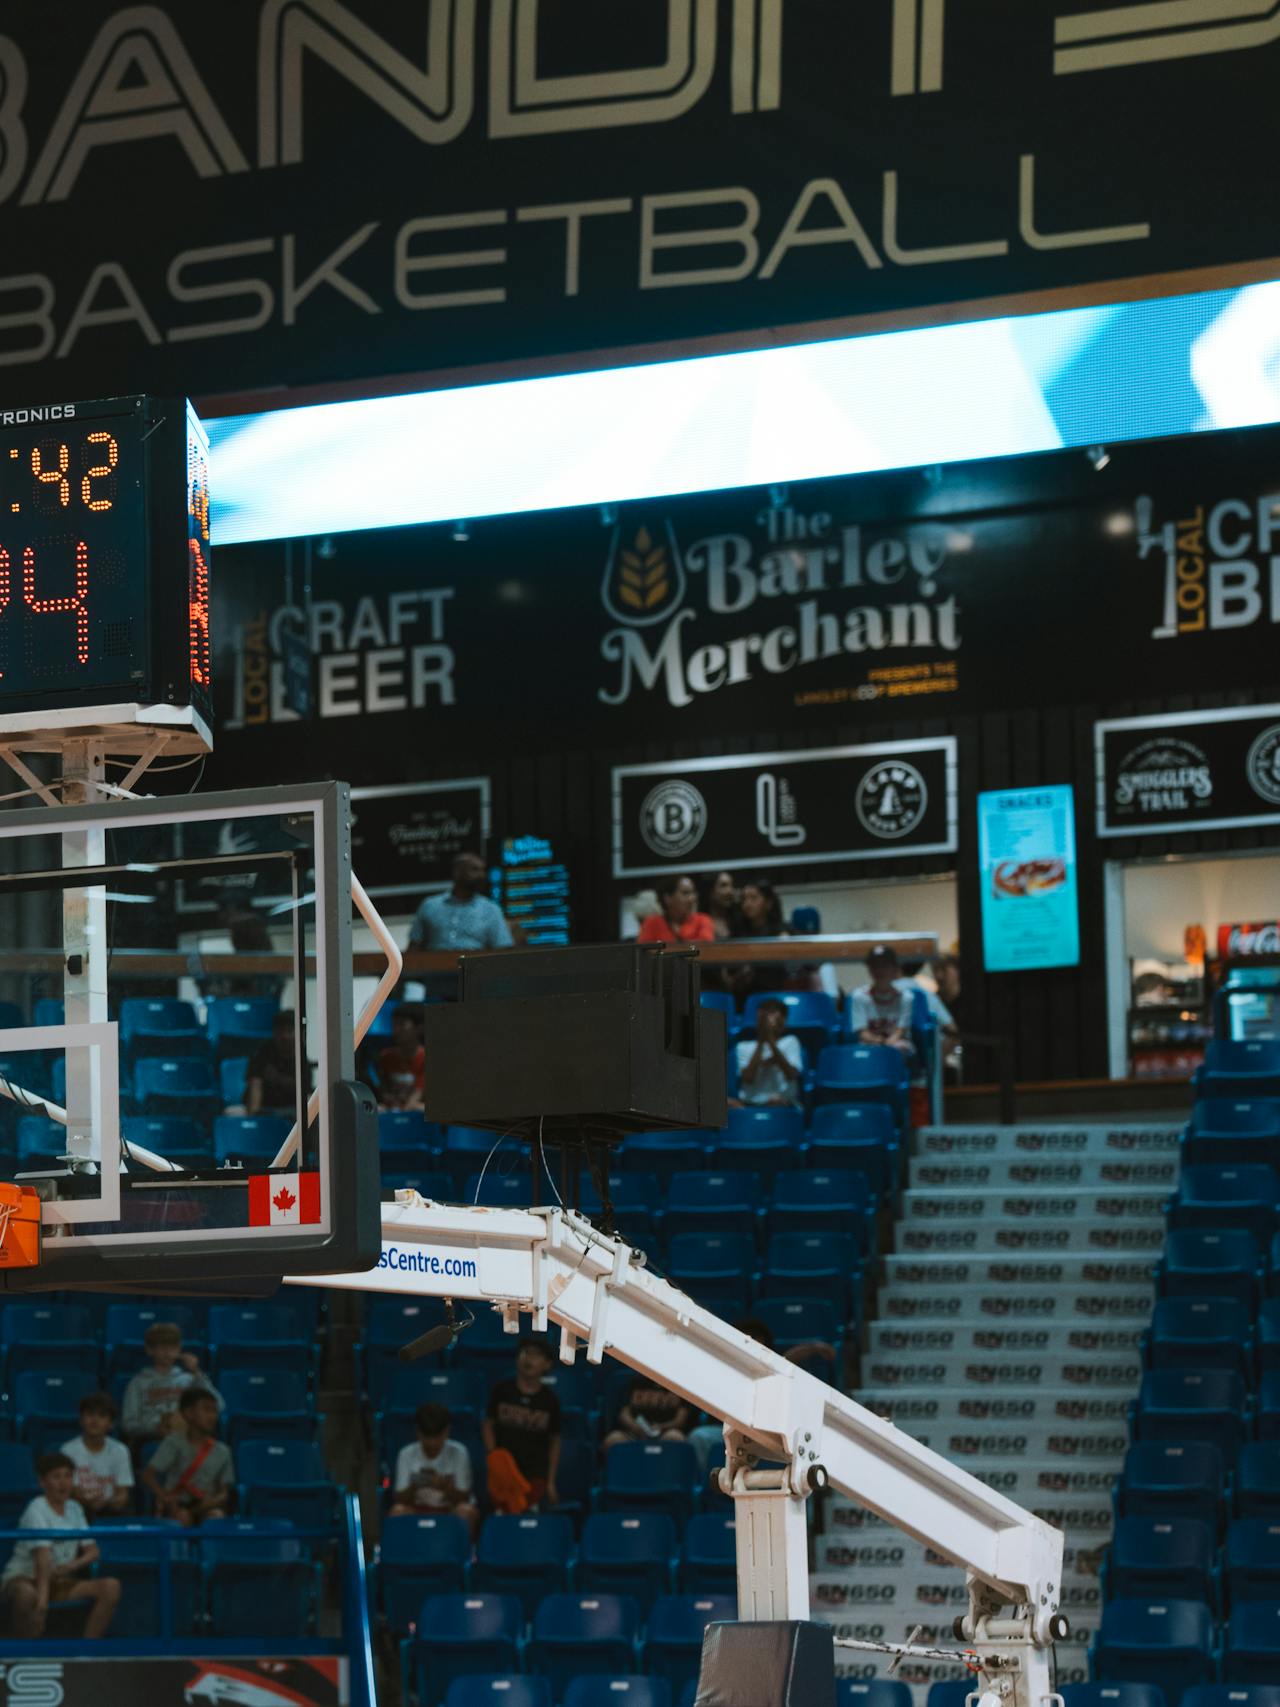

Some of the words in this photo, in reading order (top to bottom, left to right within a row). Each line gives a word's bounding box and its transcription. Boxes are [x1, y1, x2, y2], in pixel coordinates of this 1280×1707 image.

[684, 523, 948, 615] Barley
[756, 504, 832, 542] The
[1176, 505, 1206, 632] LOCAL
[597, 593, 964, 708] Merchant
